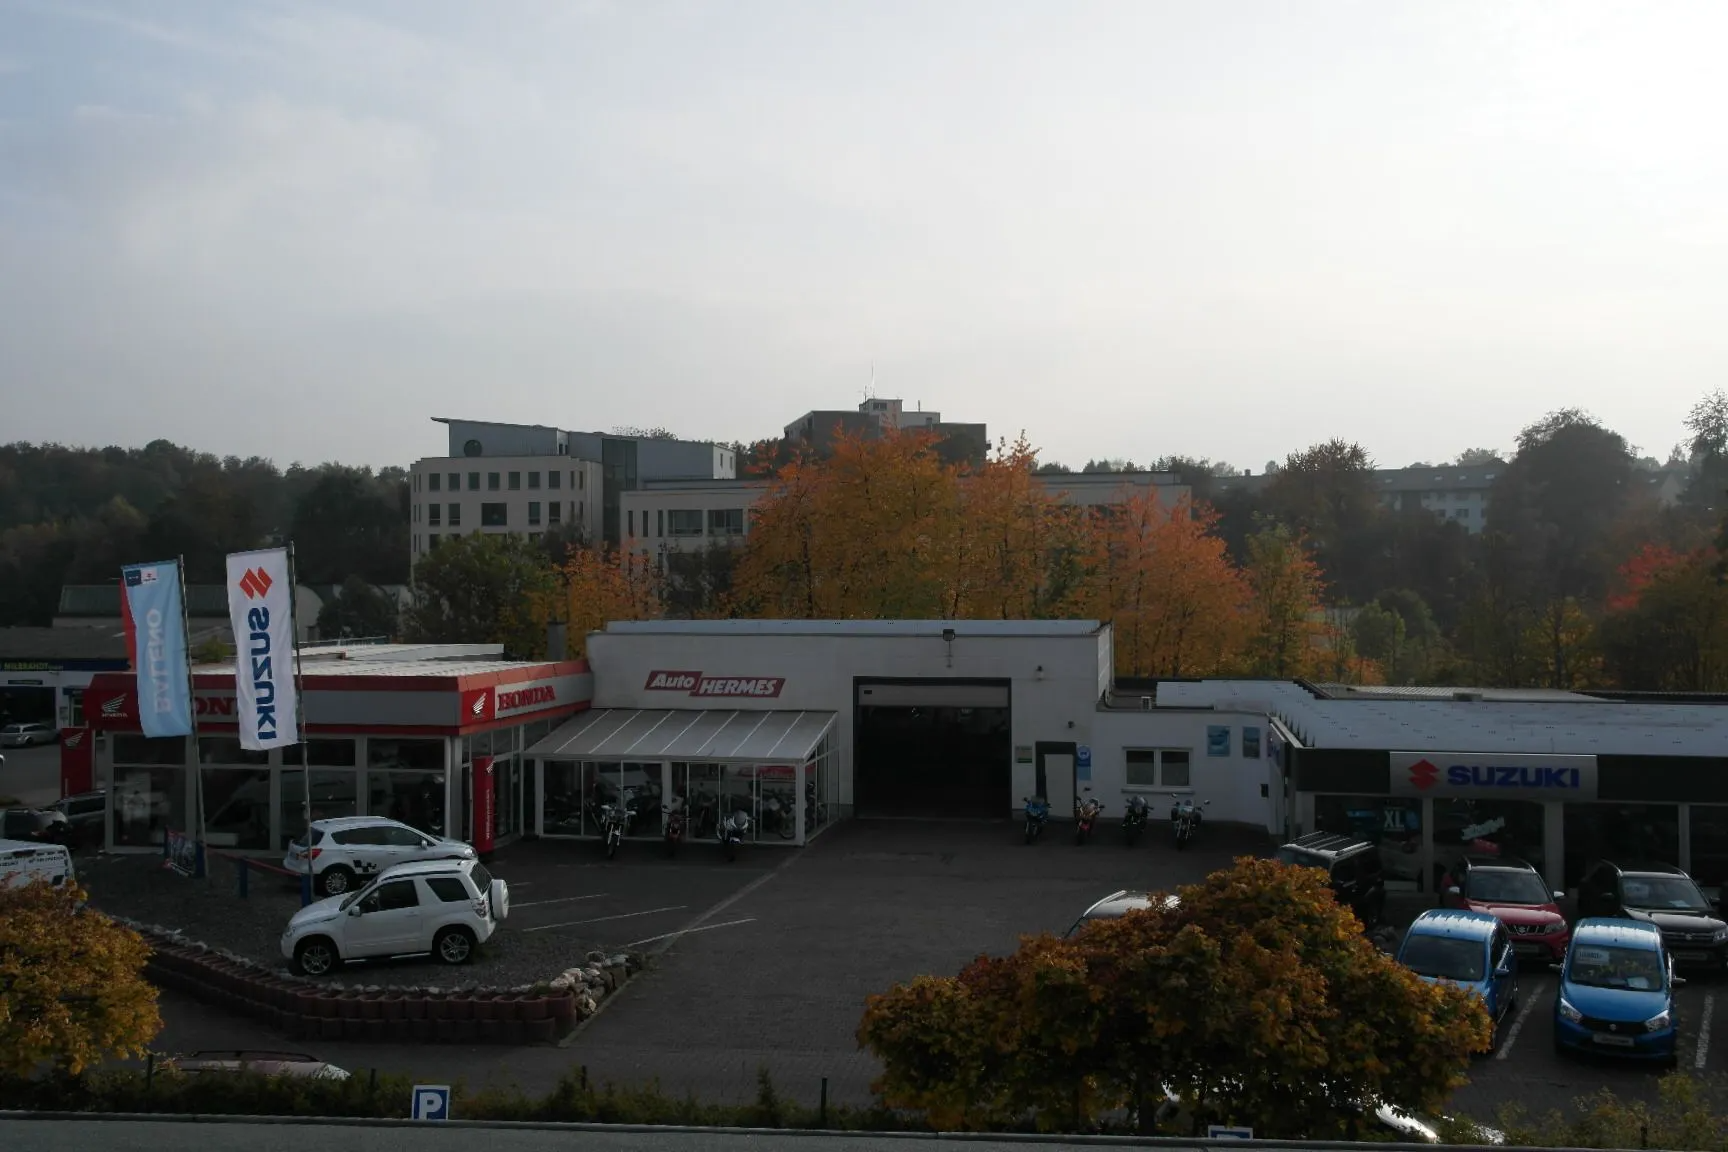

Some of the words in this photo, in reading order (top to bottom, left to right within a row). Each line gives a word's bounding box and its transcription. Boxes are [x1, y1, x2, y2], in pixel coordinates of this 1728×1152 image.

[497, 685, 556, 711] HONDA
[700, 679, 777, 695] HERMES
[1447, 765, 1580, 788] SUZUKI
[419, 1092, 443, 1120] P
